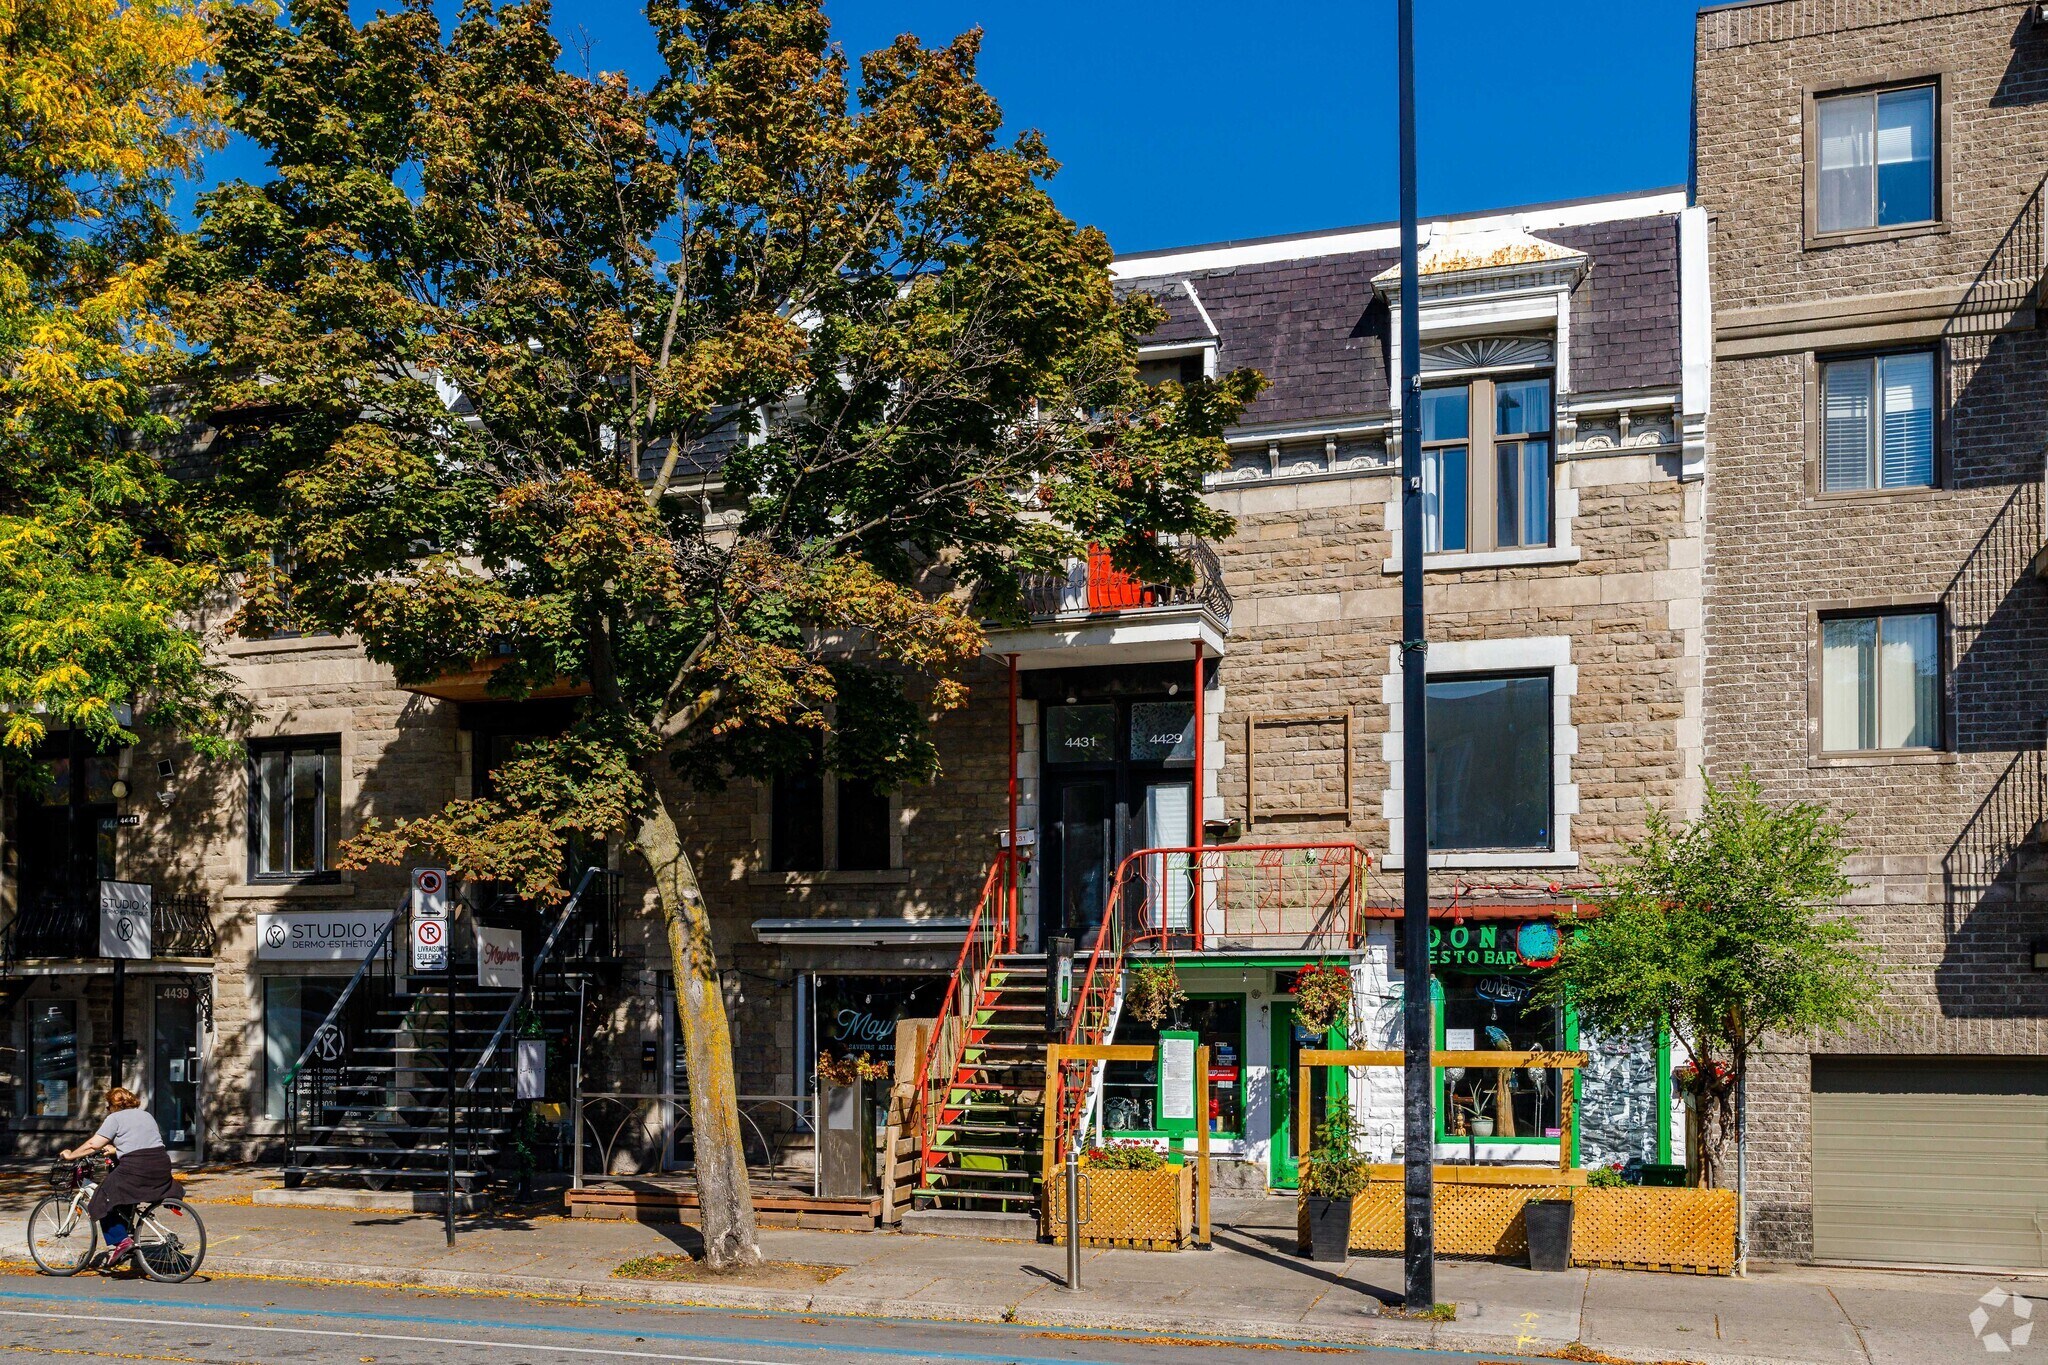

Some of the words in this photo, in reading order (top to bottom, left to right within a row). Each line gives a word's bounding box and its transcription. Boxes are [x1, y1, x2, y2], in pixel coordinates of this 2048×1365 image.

[1065, 737, 1095, 747] 4431
[1150, 734, 1182, 744] 4429
[102, 898, 139, 910] STUDIO
[142, 901, 149, 911] K
[292, 923, 367, 938] STUDIO
[373, 922, 386, 938] K
[292, 939, 384, 949] DERMO-ESTHÉTIQ
[1429, 950, 1479, 964] ESTO
[1483, 950, 1518, 964] BAR
[164, 987, 189, 999] 4439
